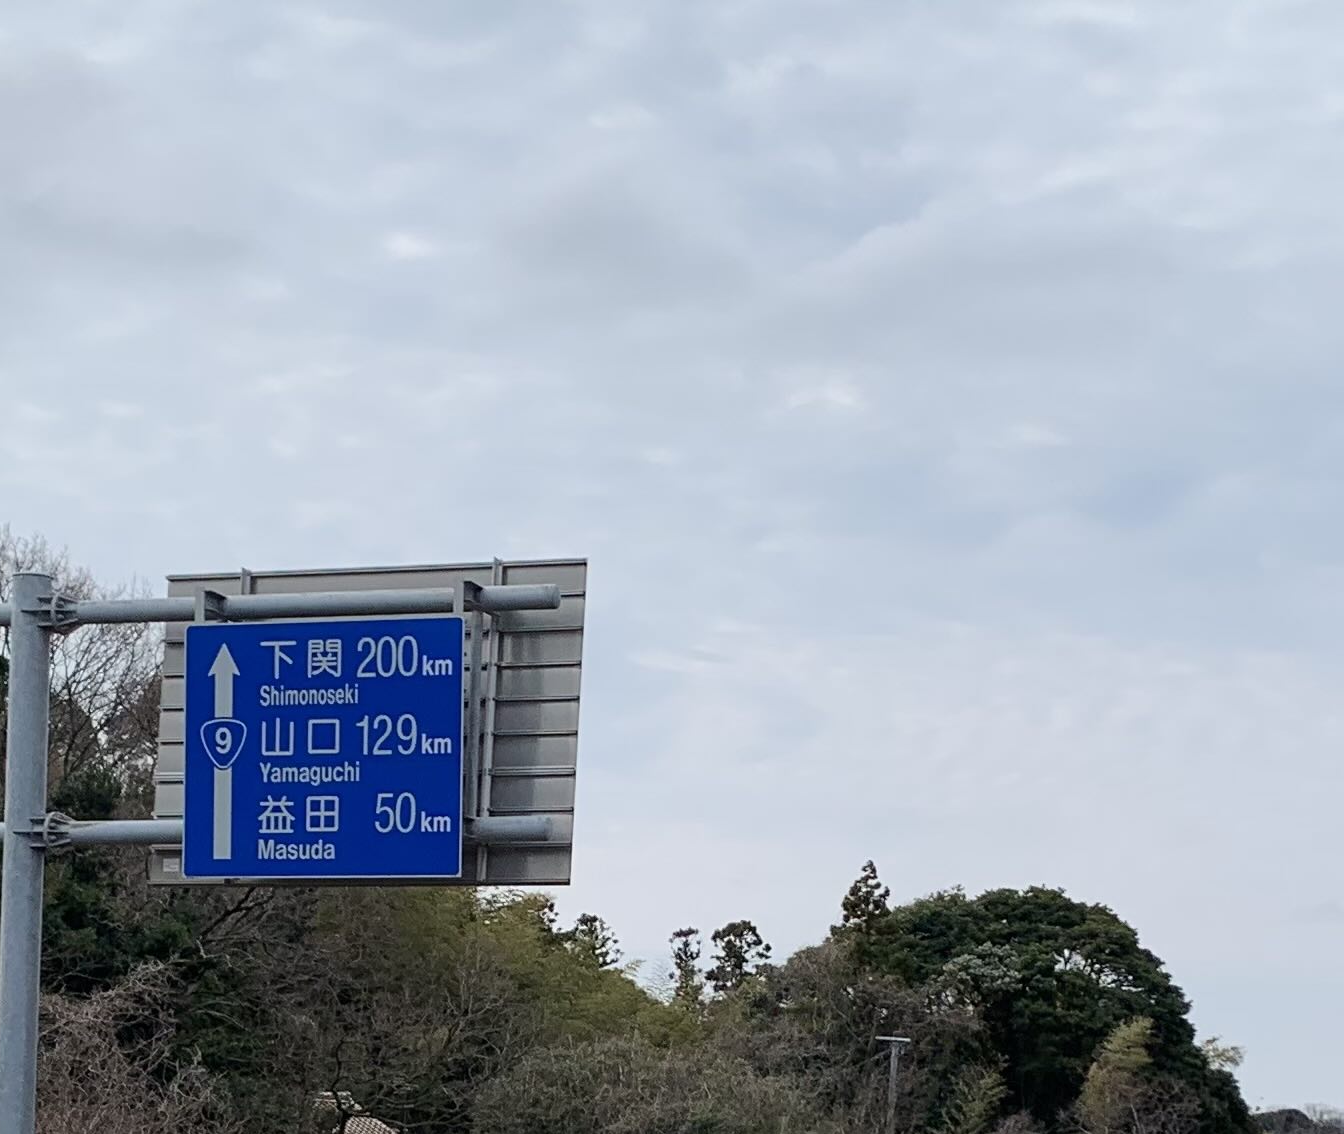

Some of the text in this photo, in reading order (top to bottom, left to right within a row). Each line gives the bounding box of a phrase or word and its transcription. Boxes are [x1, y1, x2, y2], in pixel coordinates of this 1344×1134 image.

[260, 636, 453, 680] 下関 200 km
[260, 684, 359, 707] Shimonoseki
[215, 728, 232, 754] 9
[261, 714, 452, 756] 山口 129 km
[259, 761, 360, 784] Yamaguchi
[258, 792, 451, 834] 益田 50 km
[258, 838, 336, 860] Masuda
